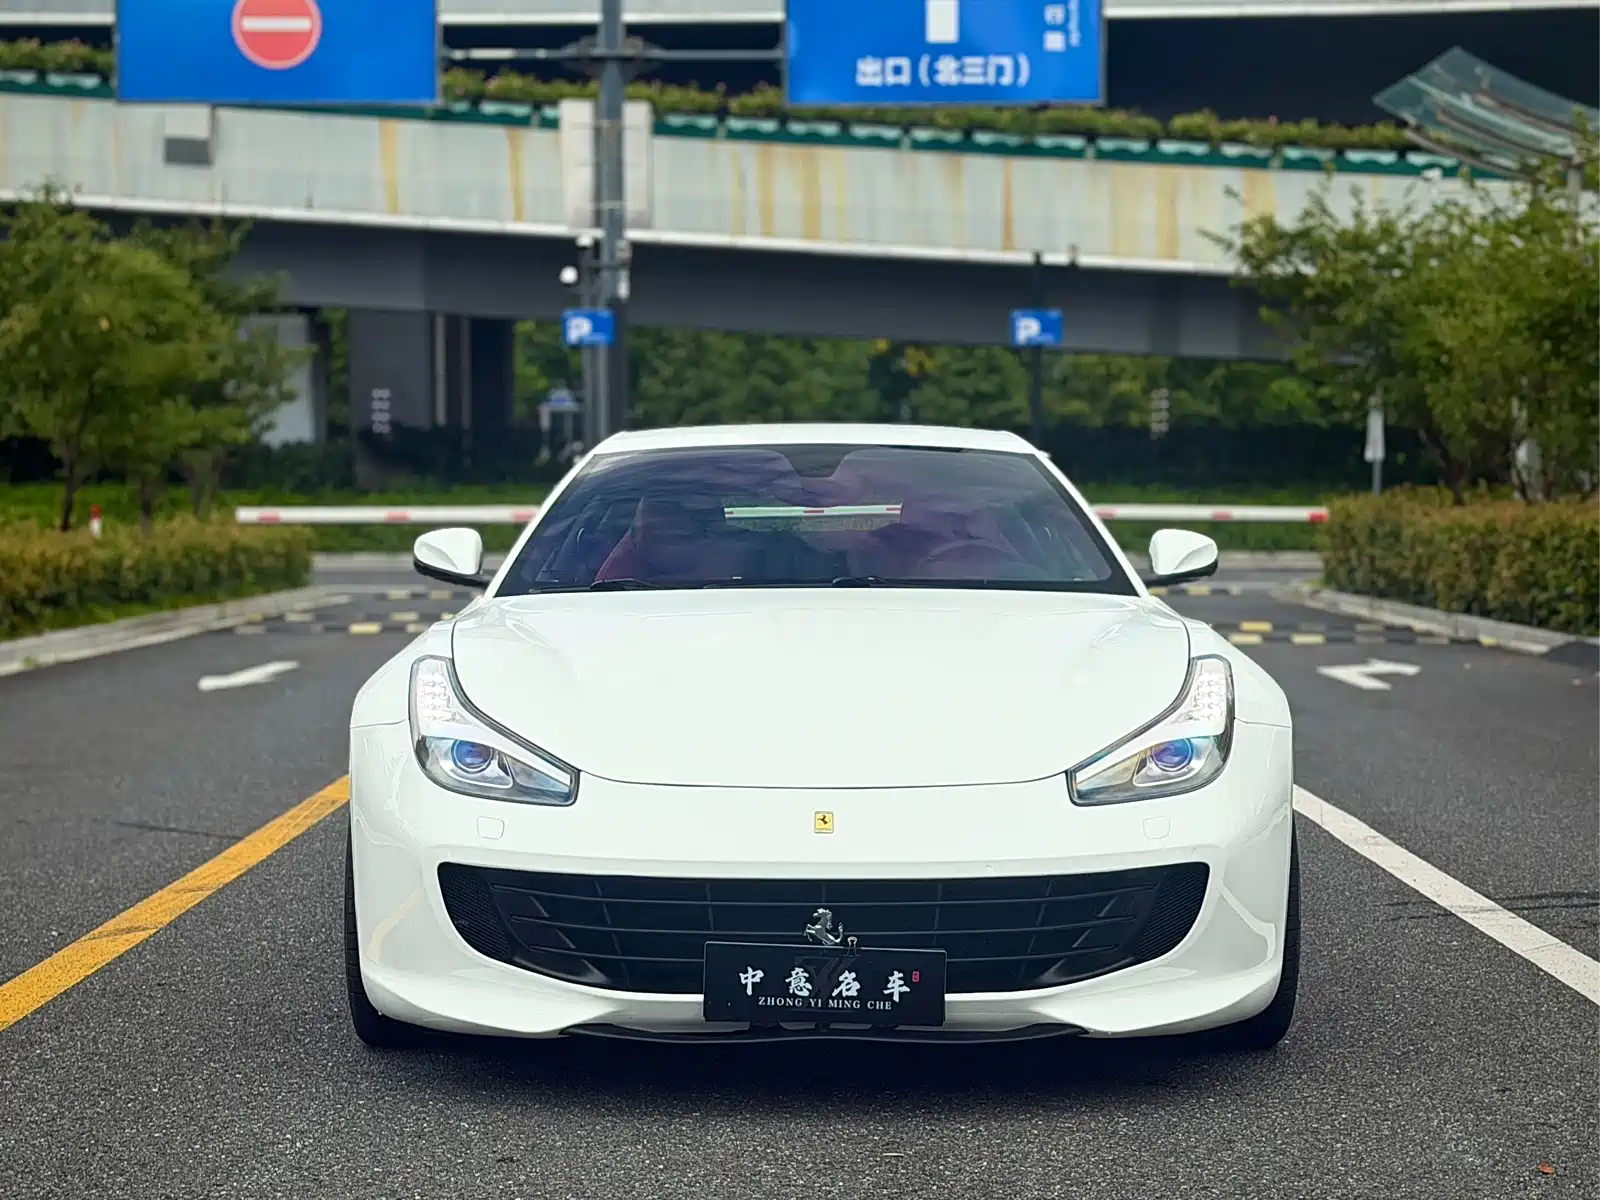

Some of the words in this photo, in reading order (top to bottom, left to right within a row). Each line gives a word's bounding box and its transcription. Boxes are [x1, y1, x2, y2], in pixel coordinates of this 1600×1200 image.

[566, 317, 593, 344] P
[1016, 317, 1041, 345] P
[739, 966, 910, 1003] 中意名车
[758, 996, 803, 1007] ZHONG
[809, 998, 822, 1008] YI
[828, 999, 861, 1009] MING
[867, 1000, 892, 1010] CHE
